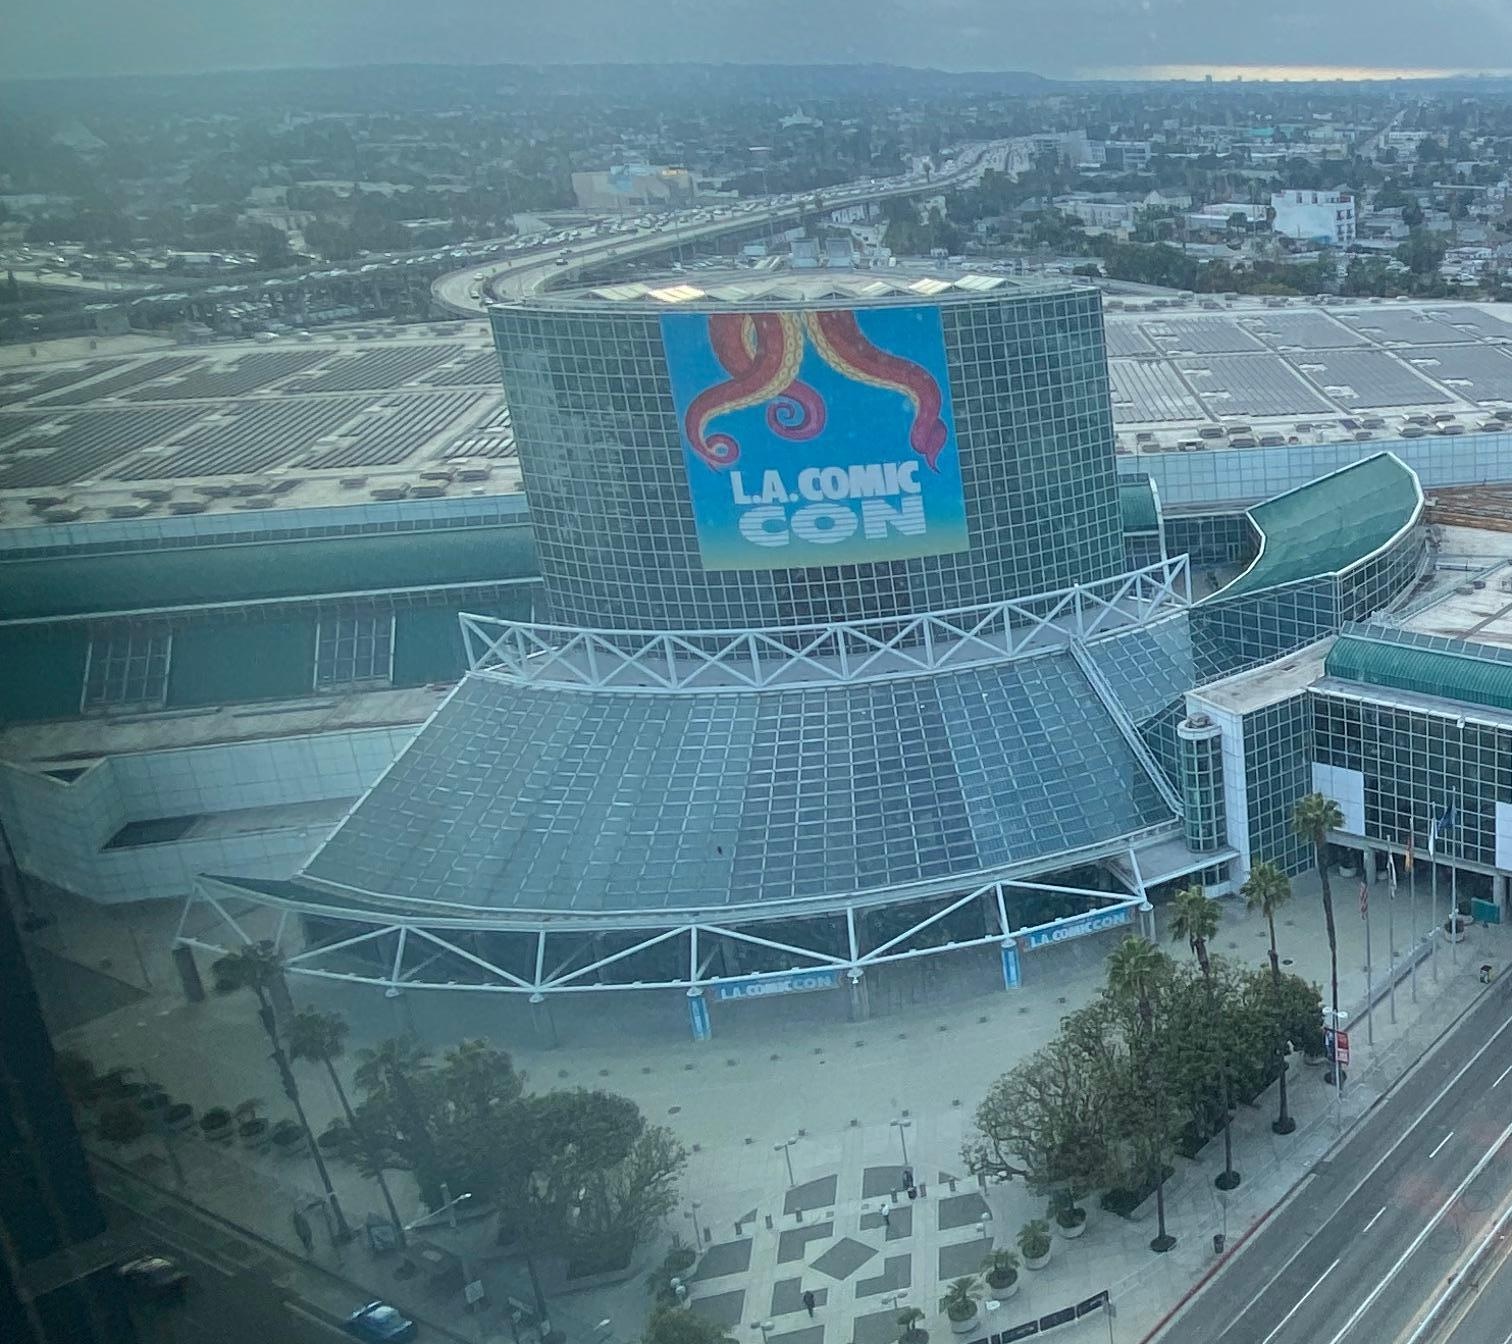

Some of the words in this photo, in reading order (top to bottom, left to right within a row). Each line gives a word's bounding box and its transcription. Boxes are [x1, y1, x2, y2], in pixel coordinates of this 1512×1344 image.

[729, 469, 798, 505] L.A.
[798, 460, 921, 501] COMIC
[738, 495, 927, 548] CON
[1092, 912, 1126, 930] CON
[792, 975, 832, 989] CON
